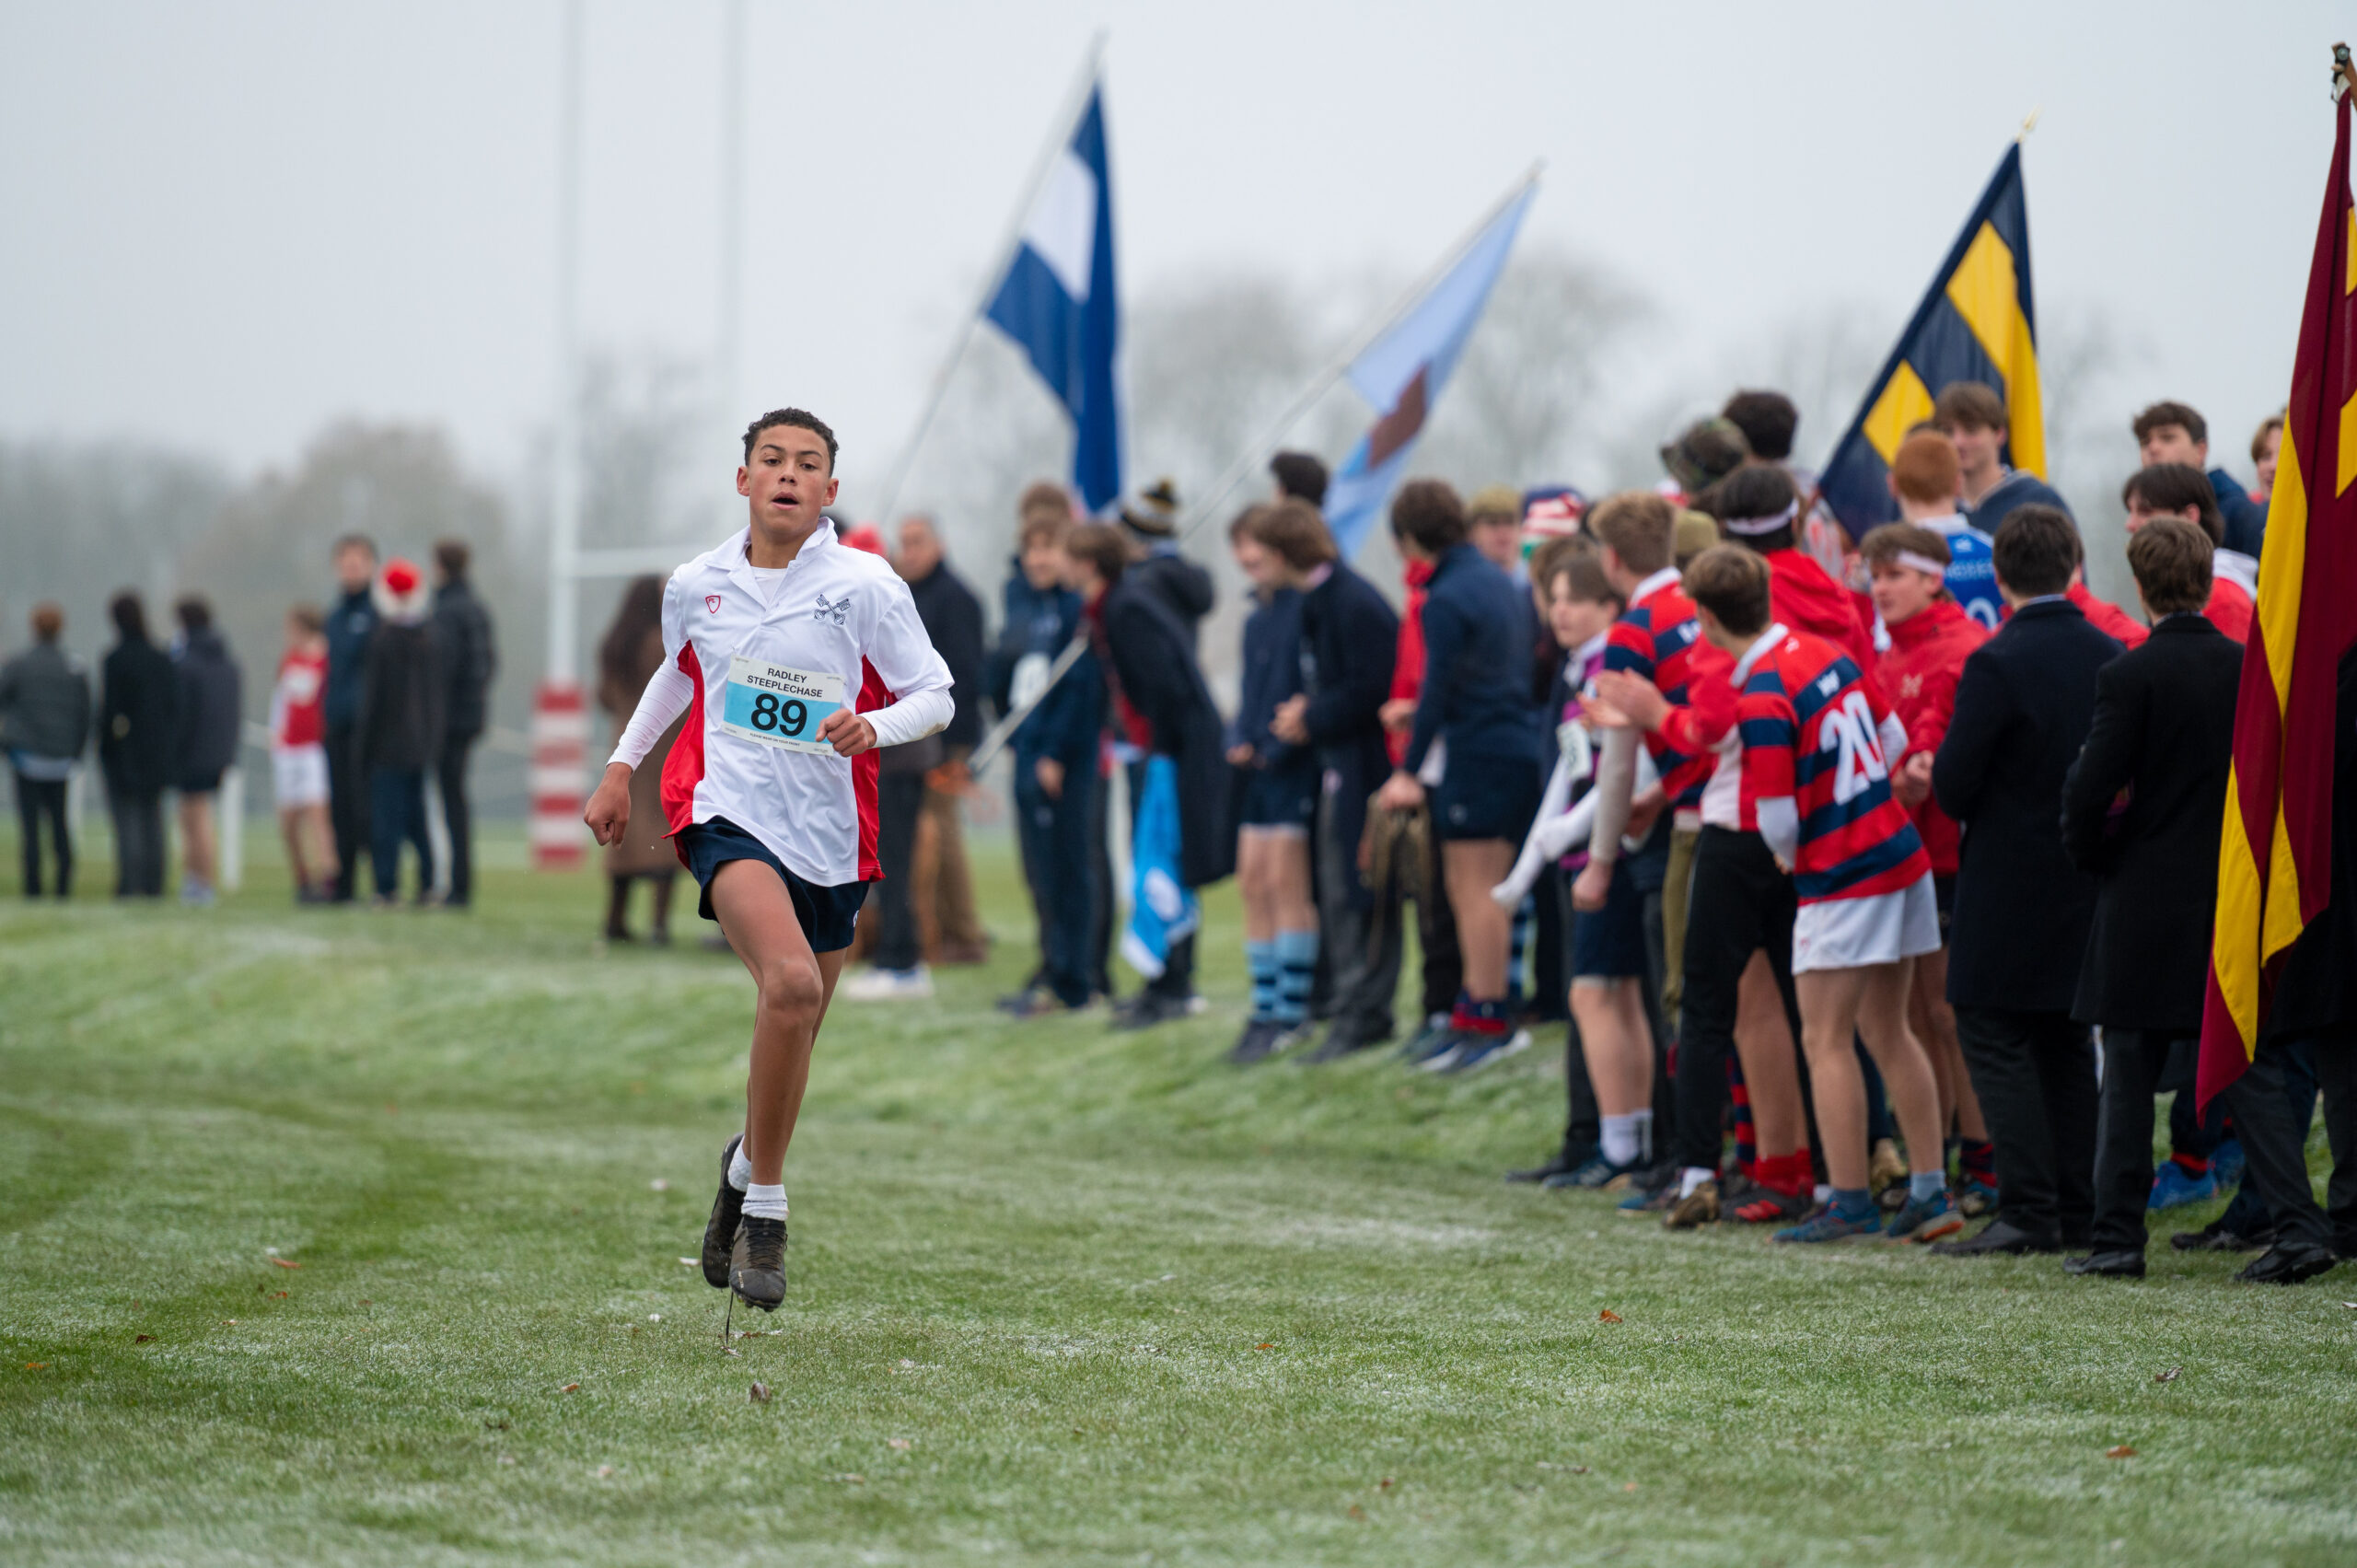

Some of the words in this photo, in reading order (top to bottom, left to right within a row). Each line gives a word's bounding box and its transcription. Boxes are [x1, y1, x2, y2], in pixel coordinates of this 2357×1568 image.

[747, 675, 823, 698] STEEPLECHASE
[767, 668, 807, 683] RADLEY
[750, 692, 807, 738] 89
[1819, 690, 1887, 806] 20
